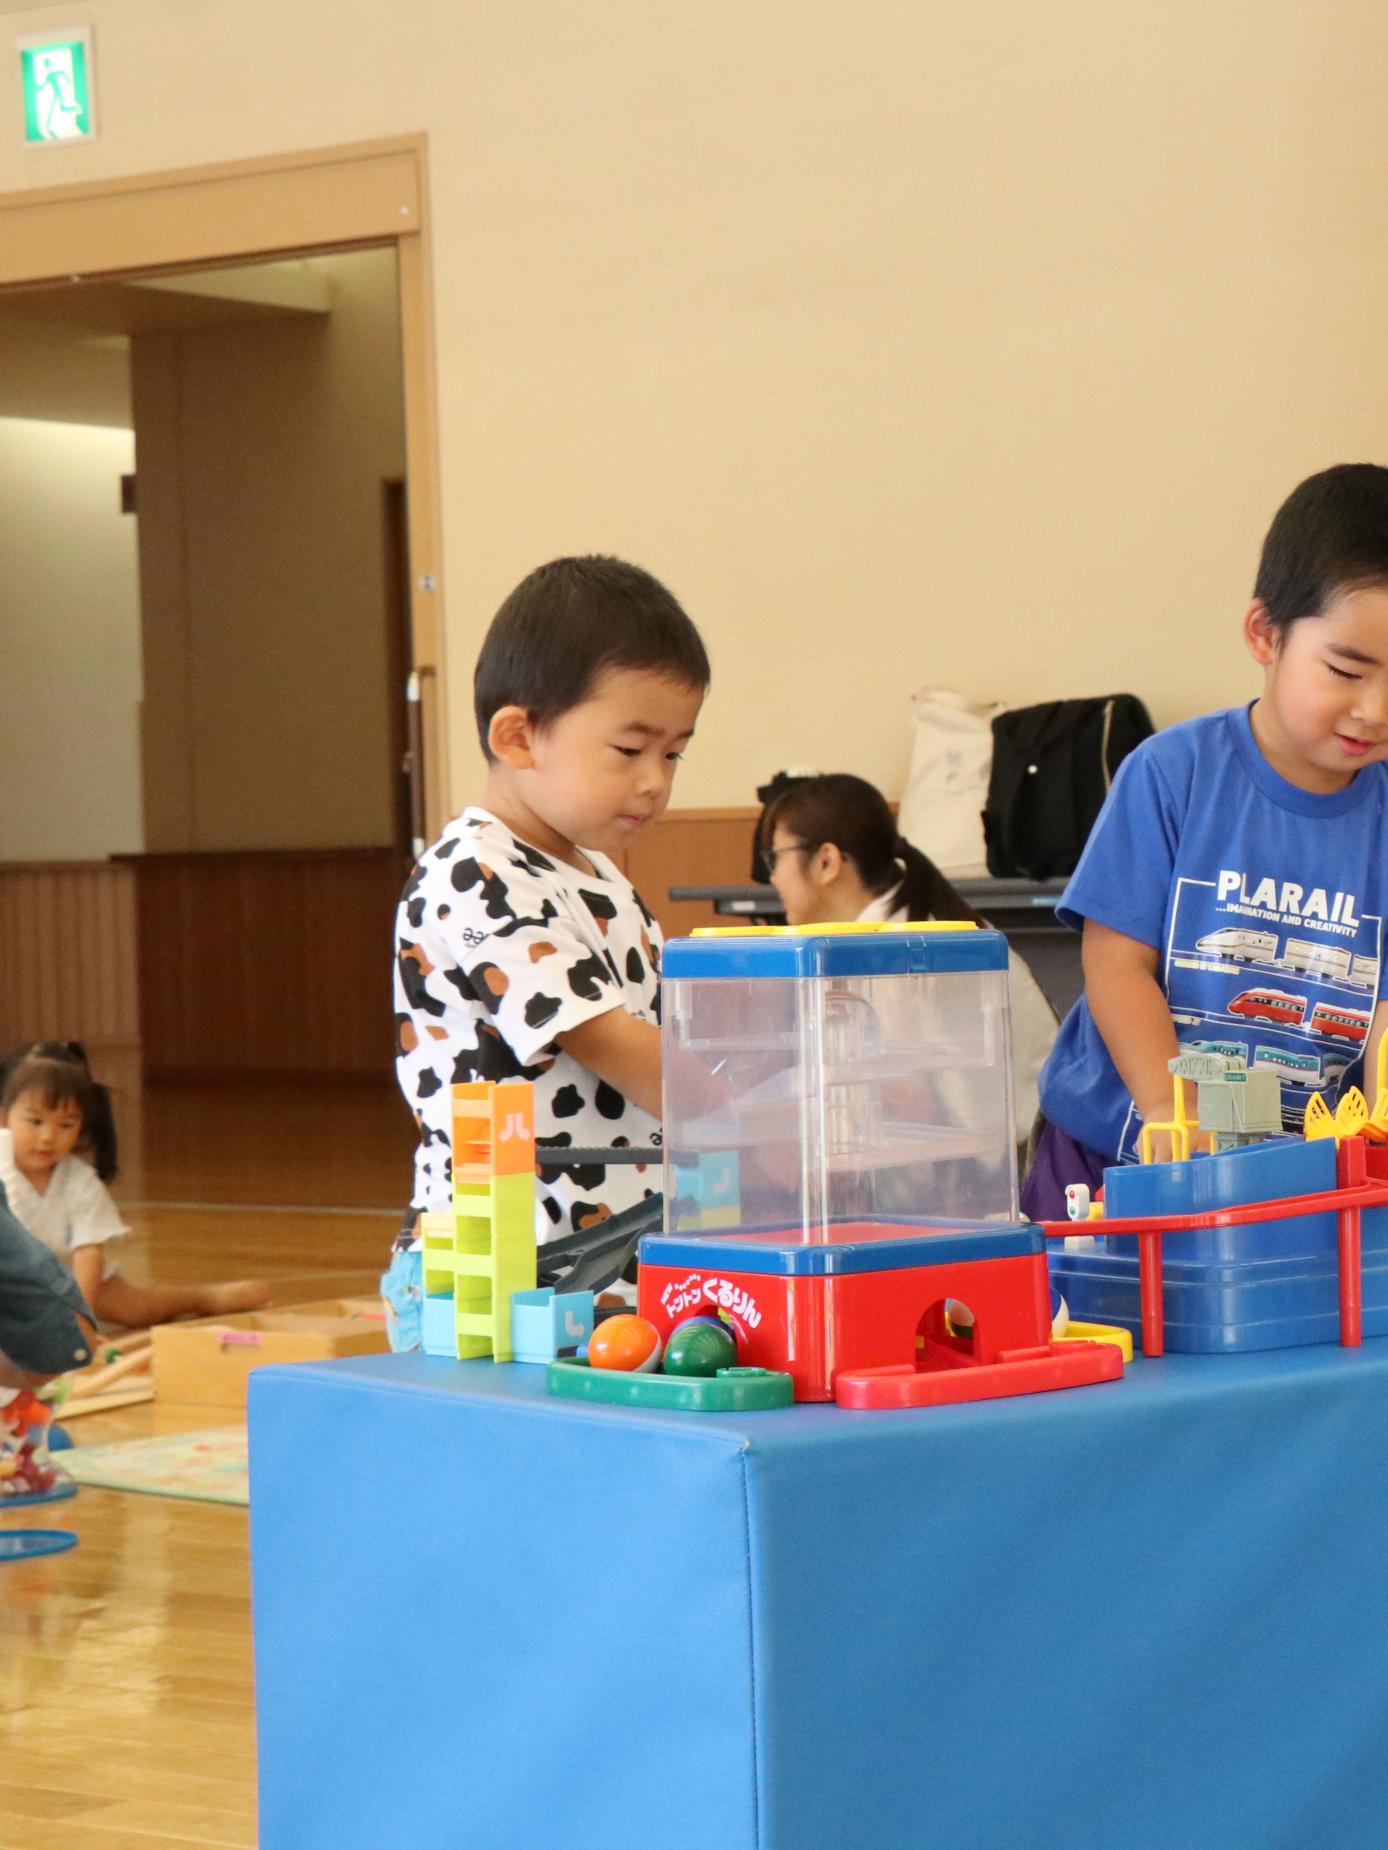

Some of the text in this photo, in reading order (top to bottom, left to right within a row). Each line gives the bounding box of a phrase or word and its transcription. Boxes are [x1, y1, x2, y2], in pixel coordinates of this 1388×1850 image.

[1217, 870, 1360, 928] PLARAIL
[1281, 914, 1302, 926] AND
[1303, 918, 1358, 938] CREATIVITY
